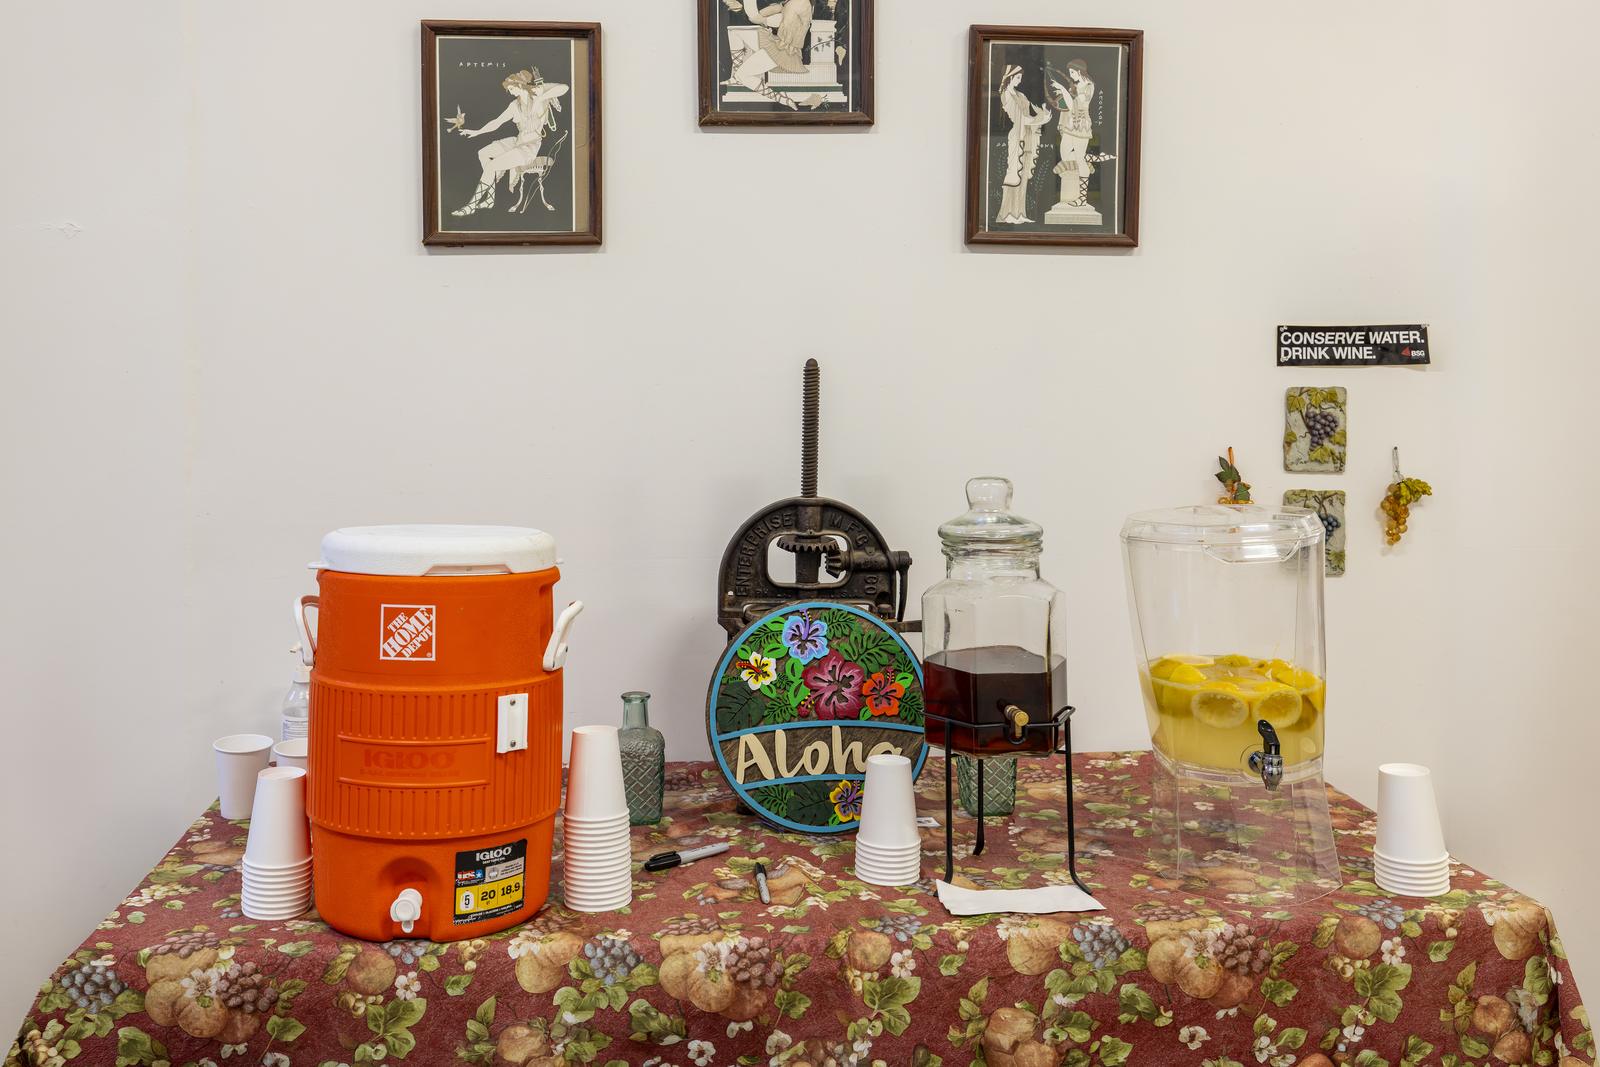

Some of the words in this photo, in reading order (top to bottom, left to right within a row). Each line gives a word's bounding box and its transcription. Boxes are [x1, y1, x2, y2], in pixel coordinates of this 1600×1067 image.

[1280, 331, 1365, 345] CONSERVE
[1369, 330, 1425, 344] WATER.
[1280, 346, 1330, 361] DRINK
[1332, 346, 1377, 360] WINE.
[382, 607, 433, 657] HOME
[387, 612, 408, 633] THE
[401, 626, 433, 658] DEPOT
[363, 749, 456, 770] IGLOO
[475, 846, 512, 862] IGLOO
[464, 894, 471, 906] 5
[480, 889, 496, 902] 20
[500, 882, 521, 897] 18.9
